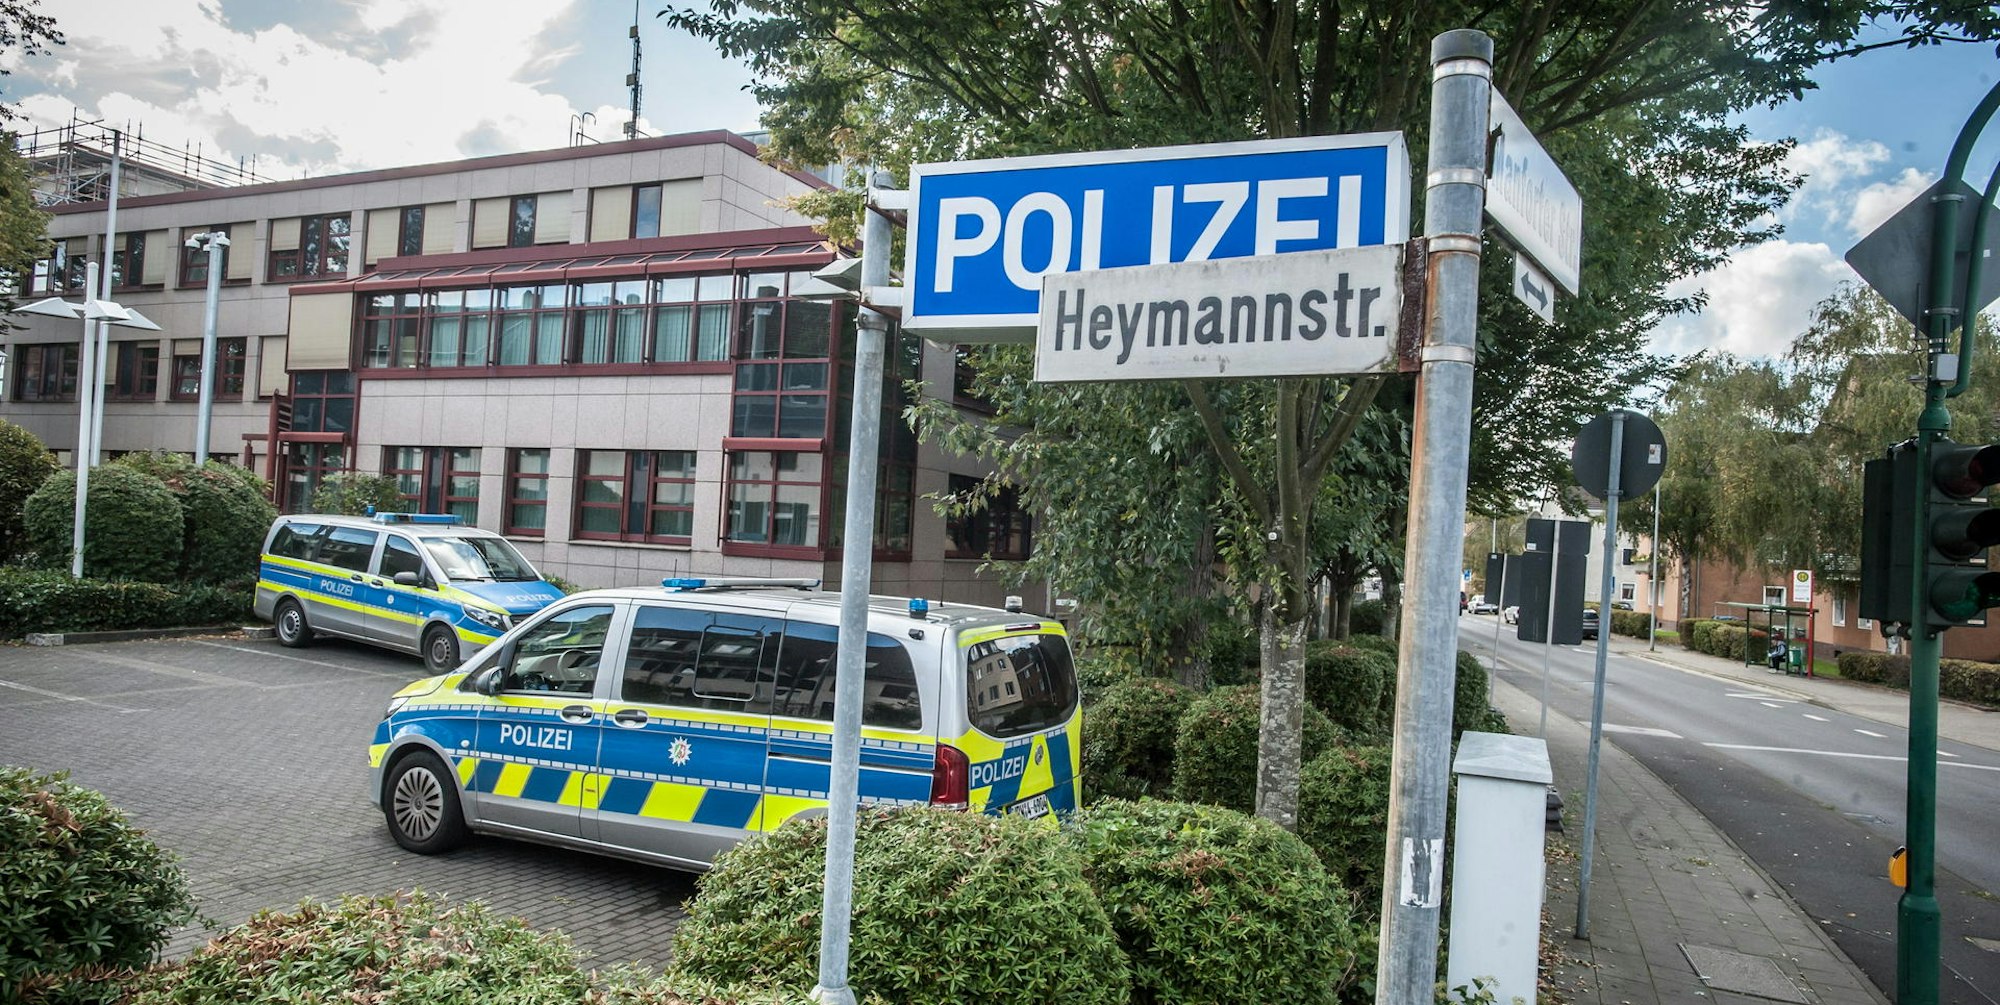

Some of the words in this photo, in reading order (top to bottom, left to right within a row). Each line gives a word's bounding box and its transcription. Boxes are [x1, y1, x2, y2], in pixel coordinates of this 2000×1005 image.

[933, 174, 1362, 293] POLIZEI
[1055, 273, 1385, 365] Heymannstr.
[320, 579, 354, 597] POLIZEI
[505, 593, 555, 603] POLIZEI
[500, 723, 573, 751] POLIZEI
[971, 755, 1025, 787] POLIZEI
